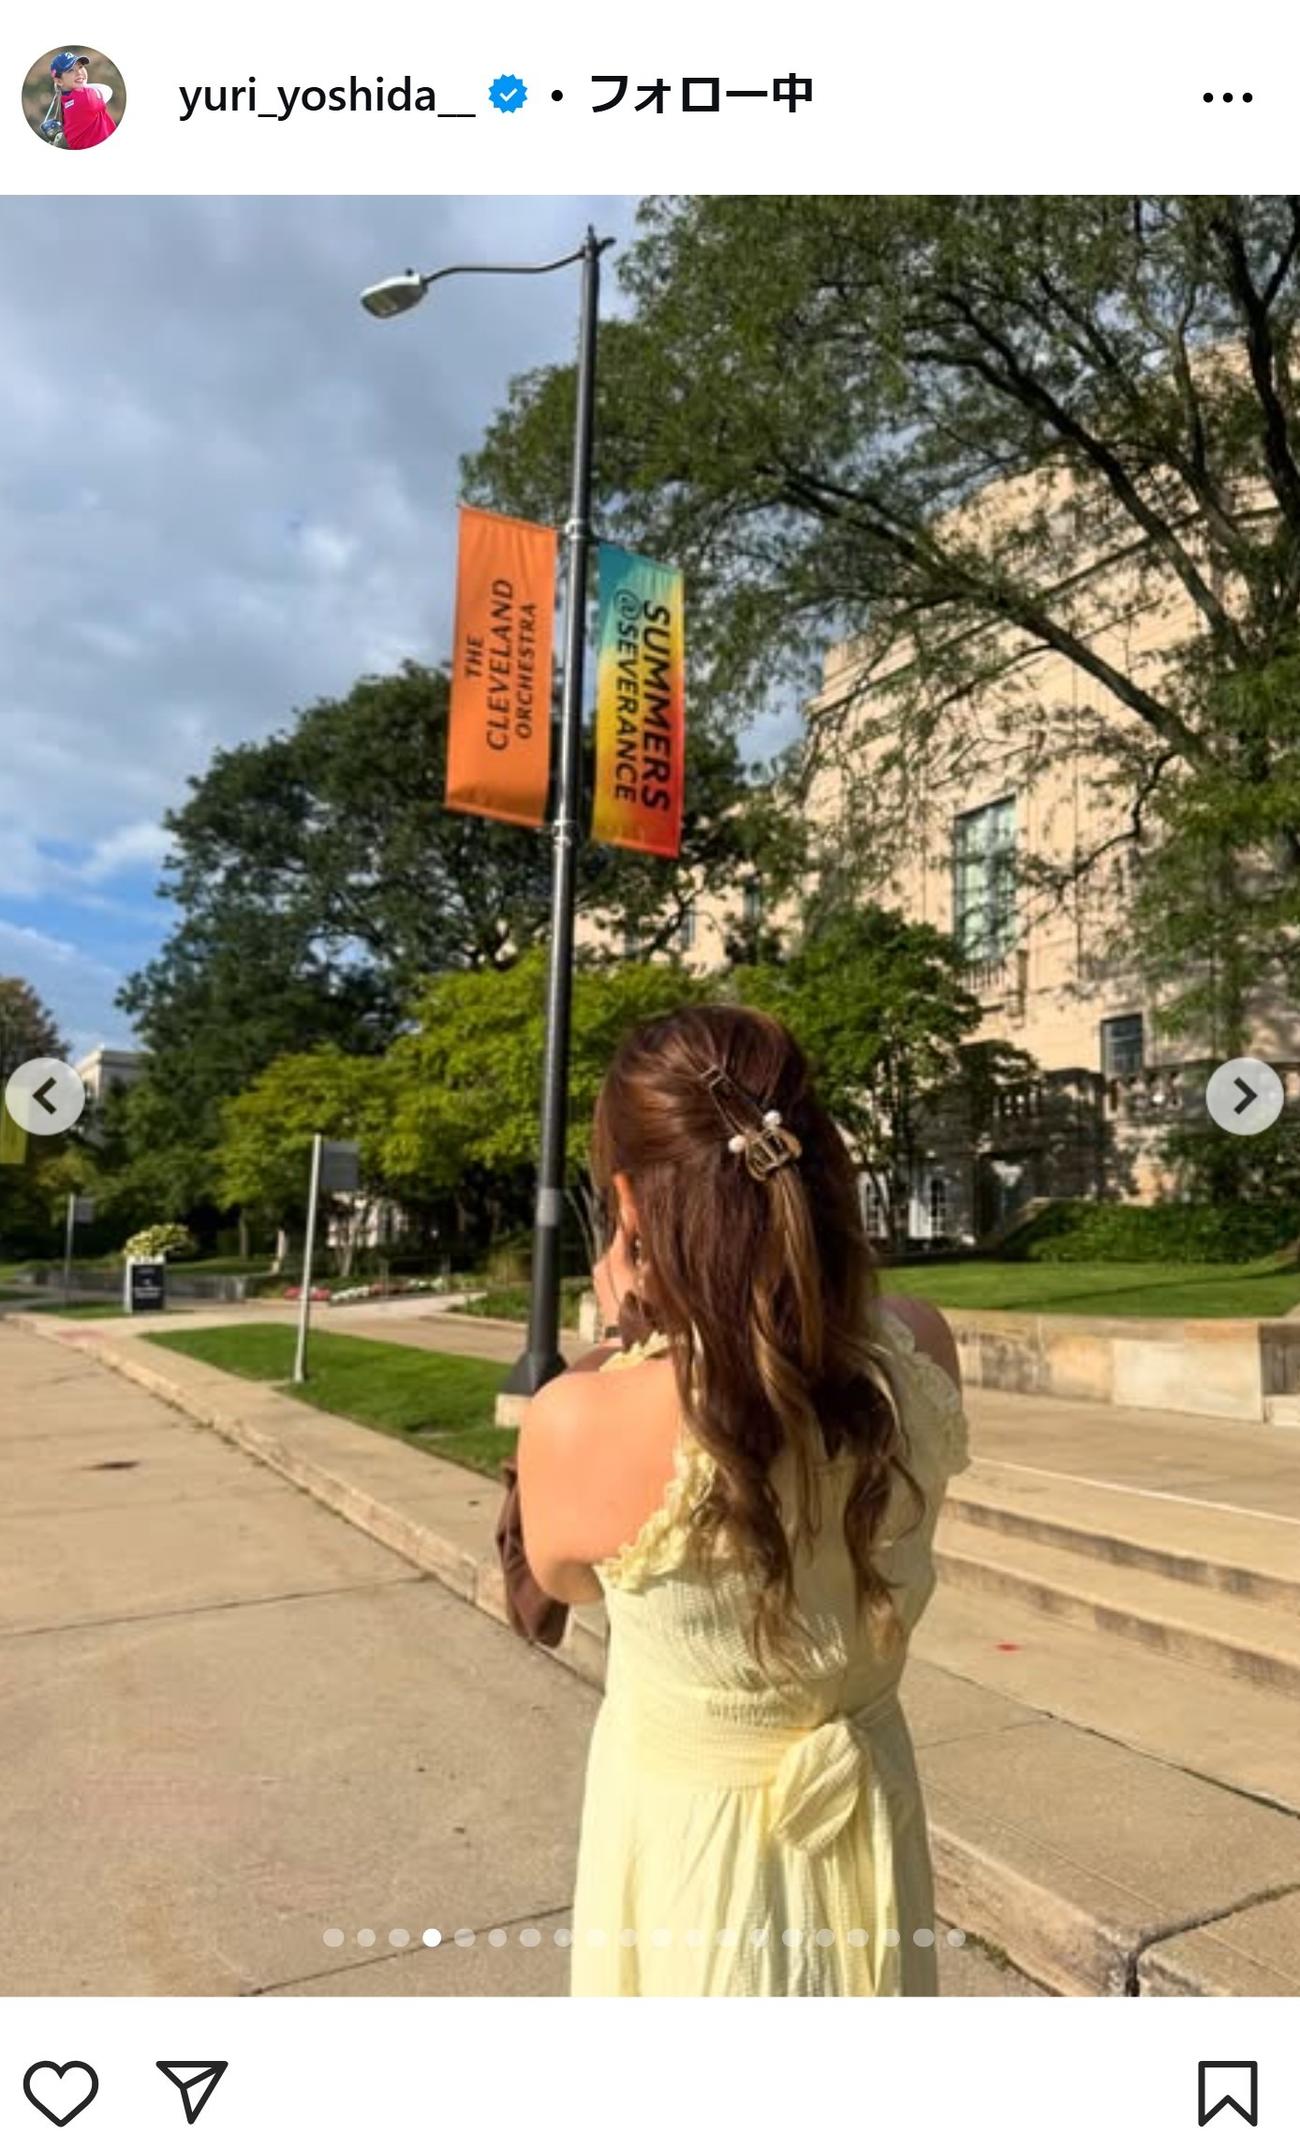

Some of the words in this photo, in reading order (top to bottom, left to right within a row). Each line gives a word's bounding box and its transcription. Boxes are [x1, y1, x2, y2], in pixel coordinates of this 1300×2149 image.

[465, 635, 484, 679] THE
[487, 579, 514, 751] CLEVELAND
[515, 603, 537, 739] ORCHESTRA
[614, 588, 641, 803] @SEVERANCE
[643, 600, 671, 812] SUMMERS
